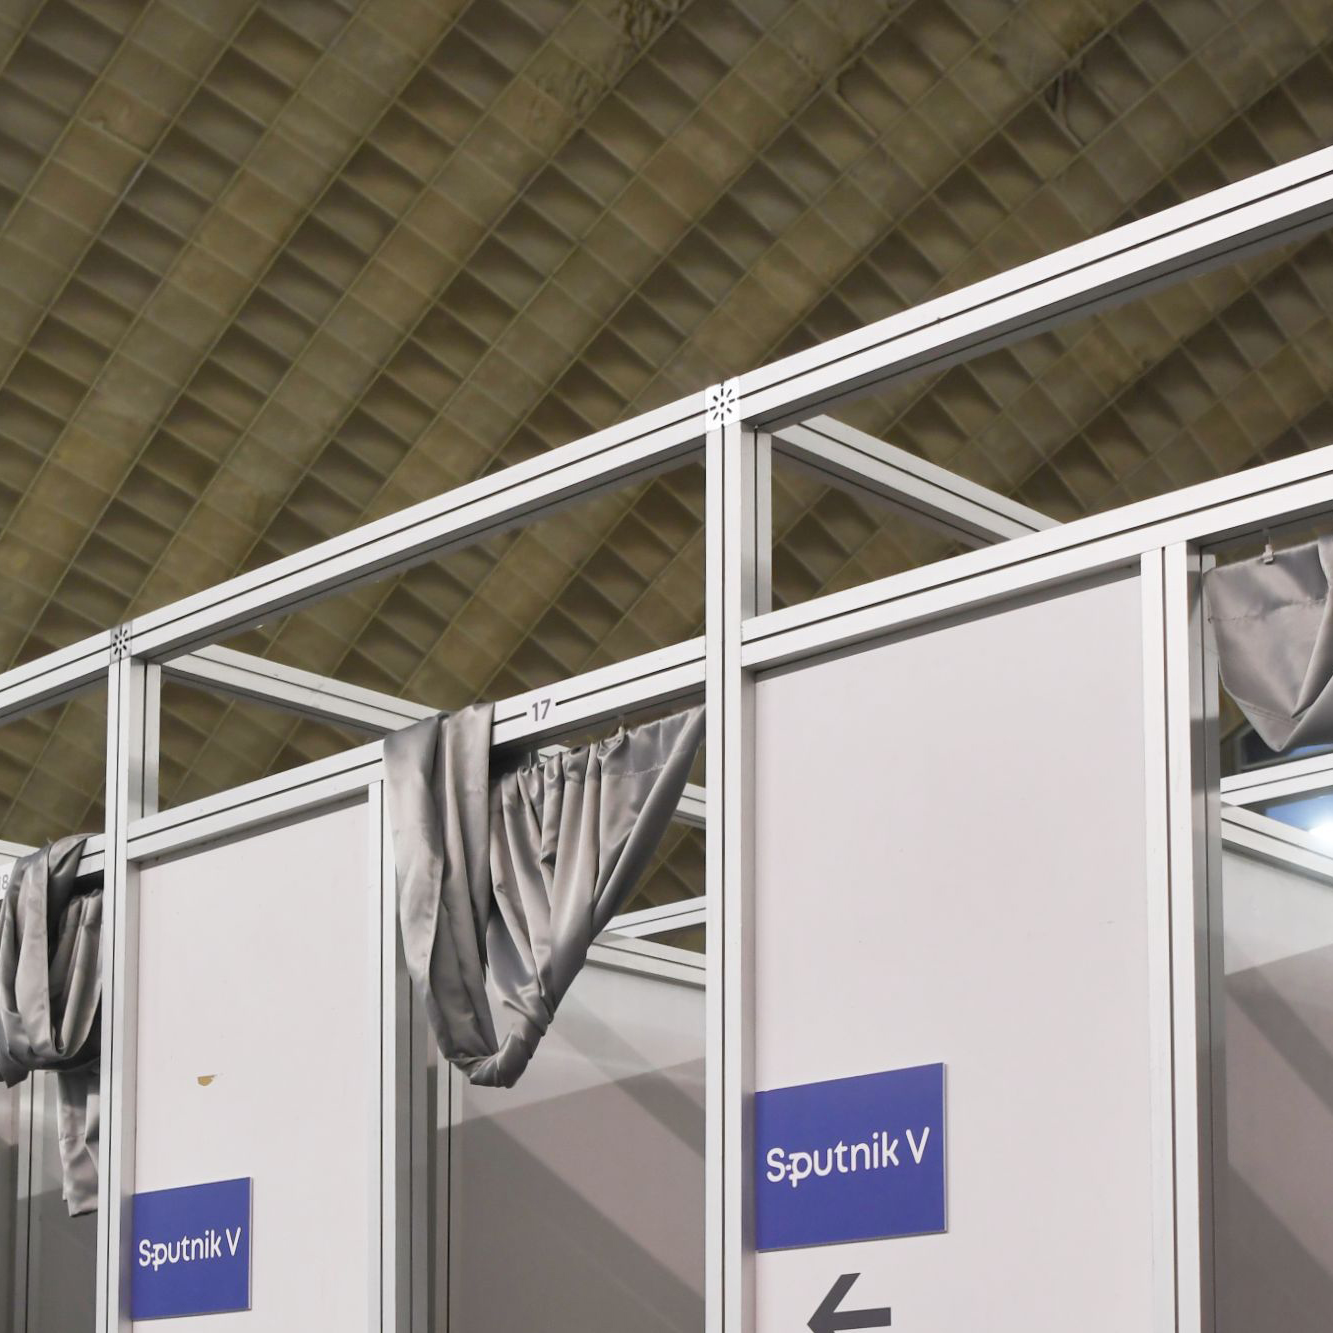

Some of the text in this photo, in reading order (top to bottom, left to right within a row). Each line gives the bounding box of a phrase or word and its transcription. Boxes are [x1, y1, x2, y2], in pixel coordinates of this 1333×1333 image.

[531, 698, 551, 722] 17
[766, 1126, 930, 1188] Sputnik V
[138, 1226, 242, 1272] Sputnik V
